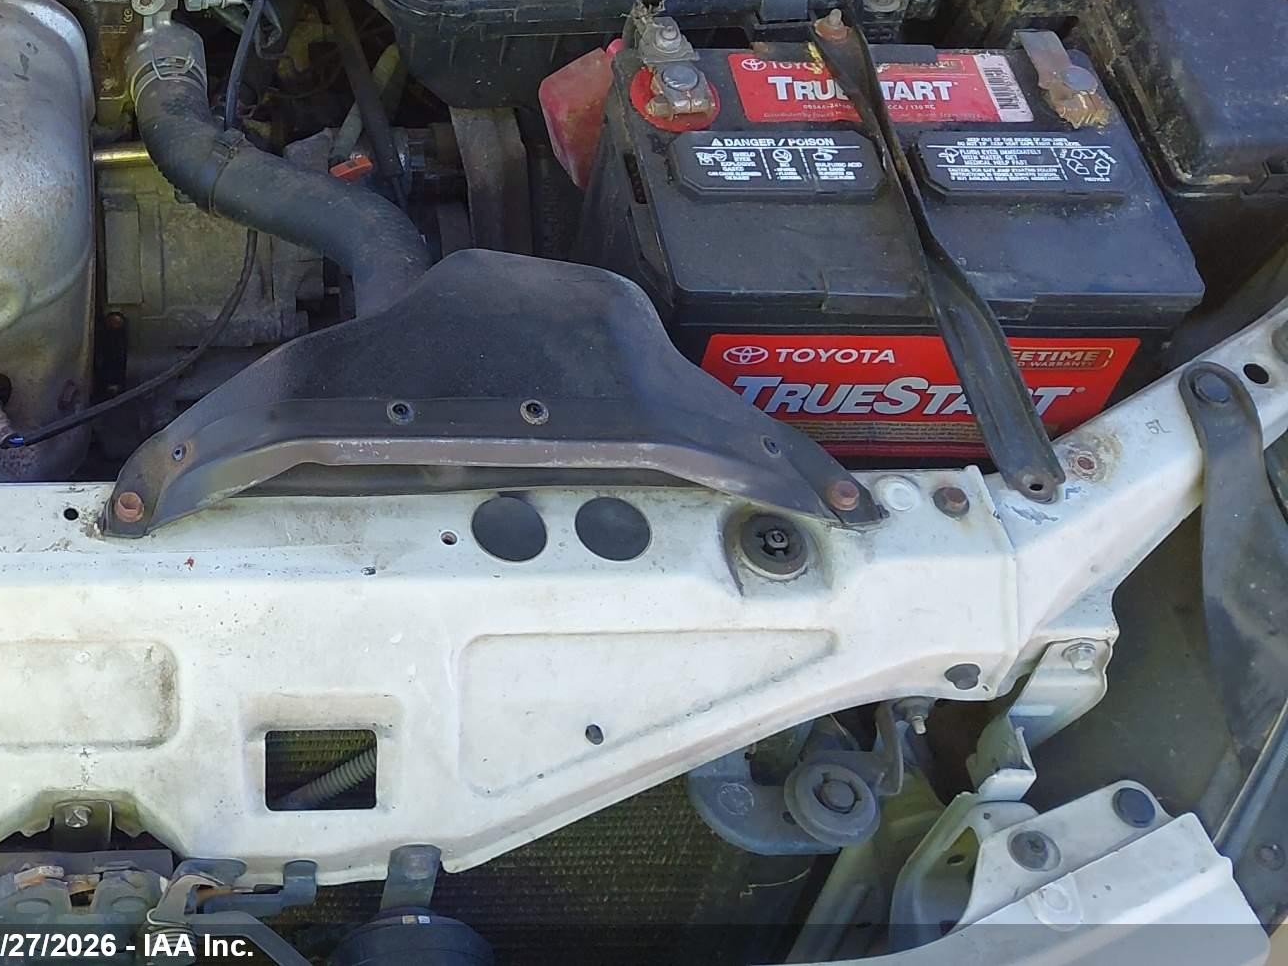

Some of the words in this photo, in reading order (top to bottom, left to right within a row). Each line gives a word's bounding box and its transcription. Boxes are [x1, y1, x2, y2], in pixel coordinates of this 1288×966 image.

[723, 138, 776, 147] DANGER
[777, 138, 786, 147] /
[787, 137, 835, 146] POISON
[775, 348, 897, 364] TOYOTA
